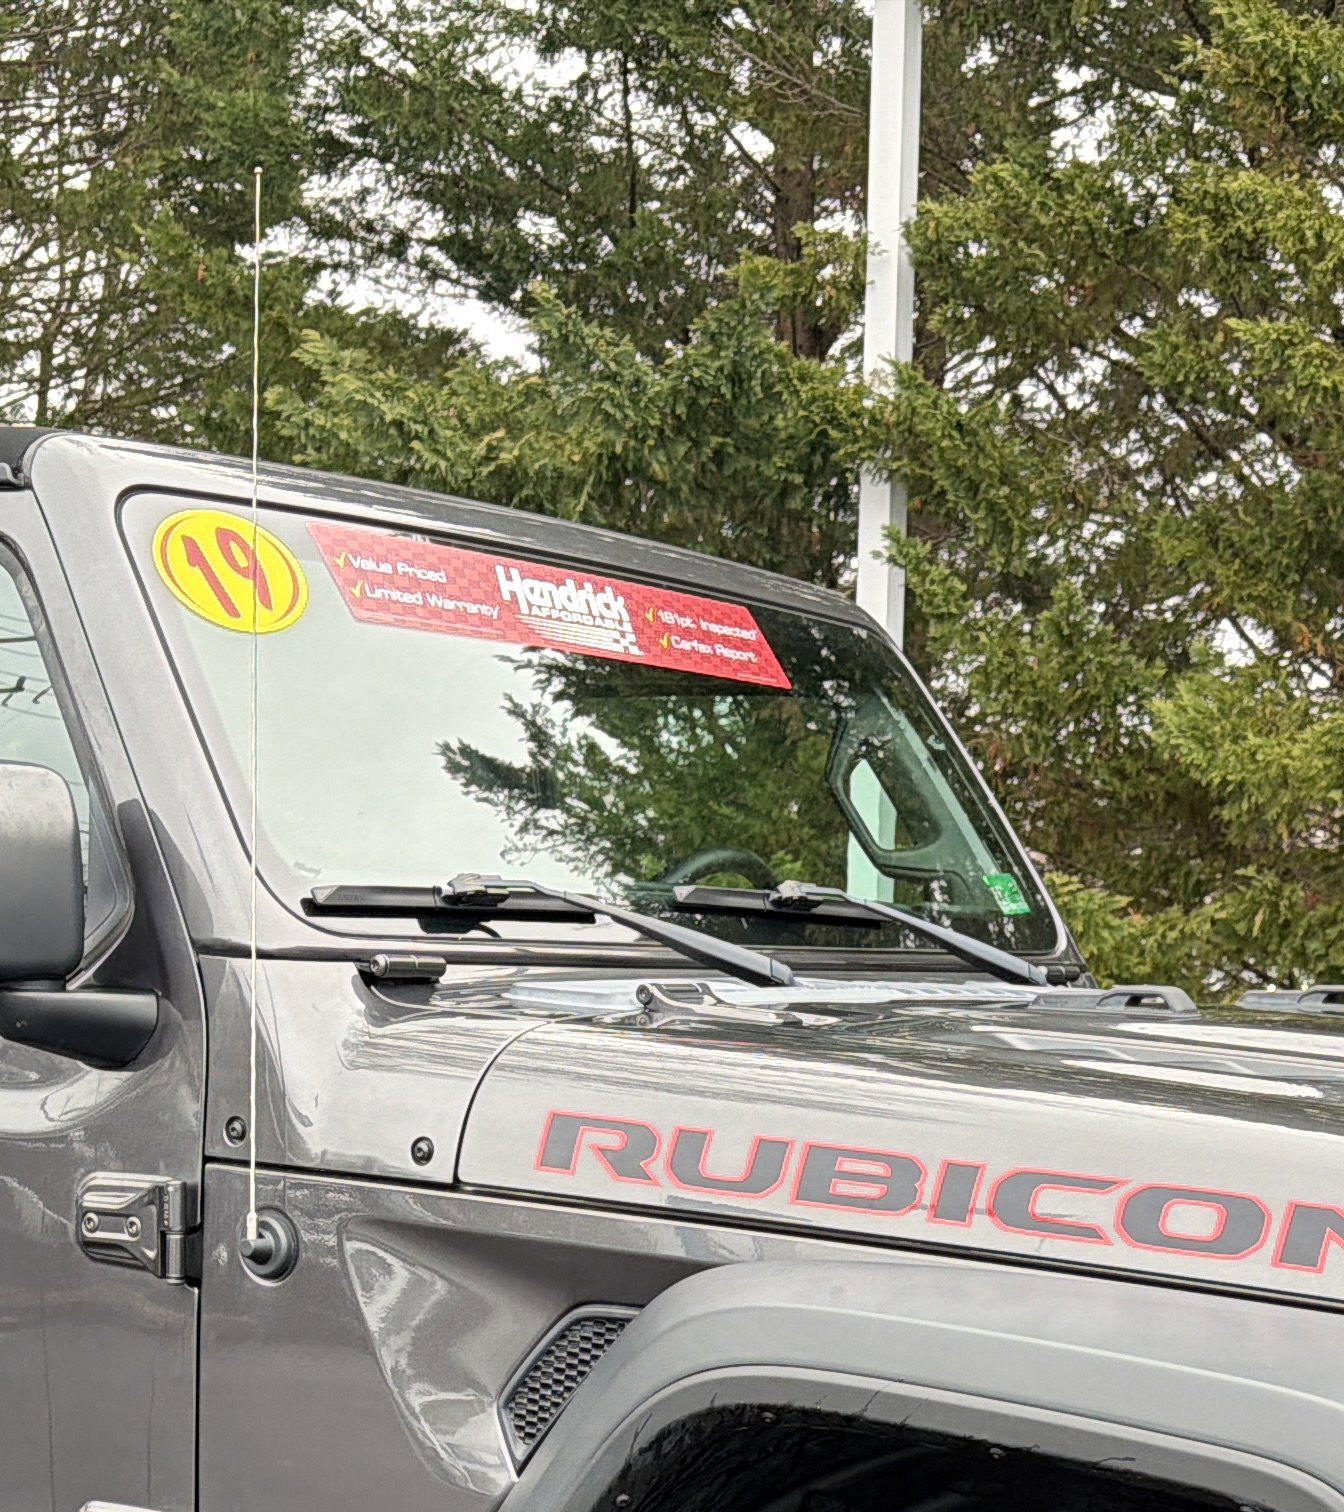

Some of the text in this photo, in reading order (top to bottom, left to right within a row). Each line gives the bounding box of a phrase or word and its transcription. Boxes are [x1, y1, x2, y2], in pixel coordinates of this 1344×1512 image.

[181, 526, 273, 619] 19
[347, 552, 448, 584] Value Priced
[363, 582, 501, 620] Limited Warranty
[495, 564, 631, 622] Hendrick
[670, 635, 760, 664] Carfax Report
